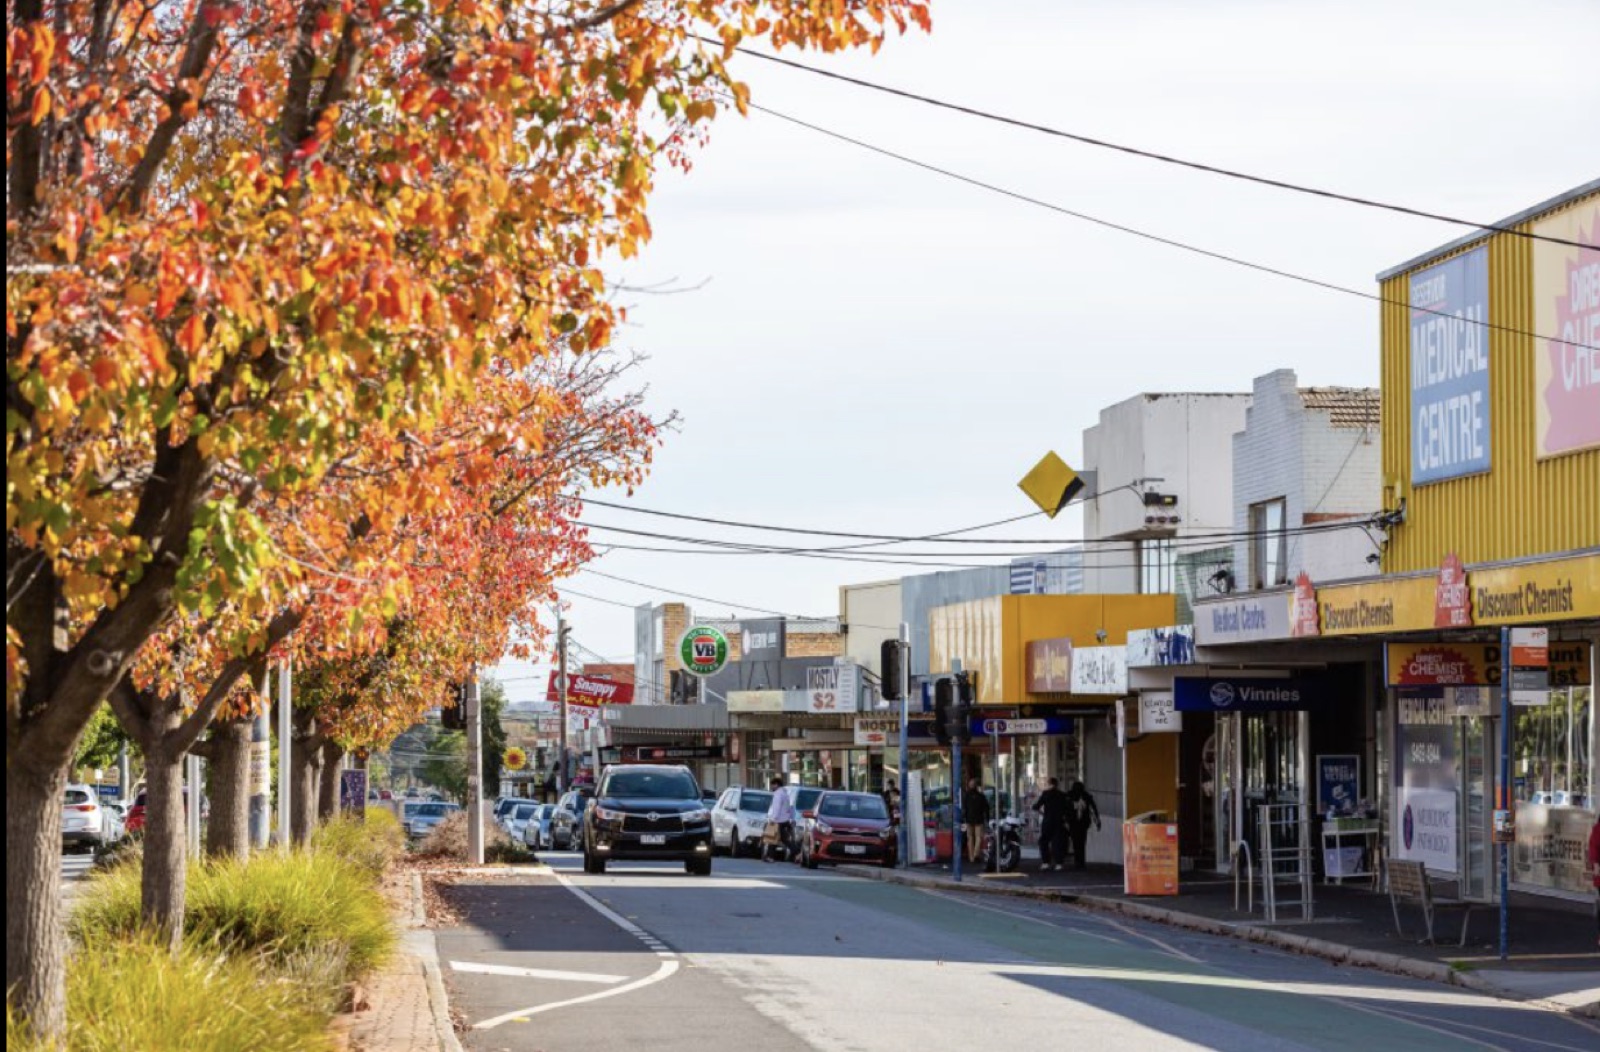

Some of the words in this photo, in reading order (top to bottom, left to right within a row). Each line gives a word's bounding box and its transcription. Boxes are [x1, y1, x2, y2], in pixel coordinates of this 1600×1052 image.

[1413, 303, 1488, 391] MEDICAL
[1562, 313, 1600, 392] CHE
[1419, 390, 1483, 471] CENTRE
[1478, 584, 1524, 619] Discount
[1525, 577, 1574, 615] Chemist
[1324, 601, 1359, 630] Discount
[1360, 597, 1394, 628] Chemist
[695, 643, 716, 657] VB
[808, 667, 840, 690] MOSTLY
[1409, 662, 1465, 676] CHEMIST
[1436, 675, 1465, 684] OUTLET
[574, 677, 617, 698] Snappy
[1239, 687, 1300, 701] Vinnies
[813, 692, 836, 710] $2
